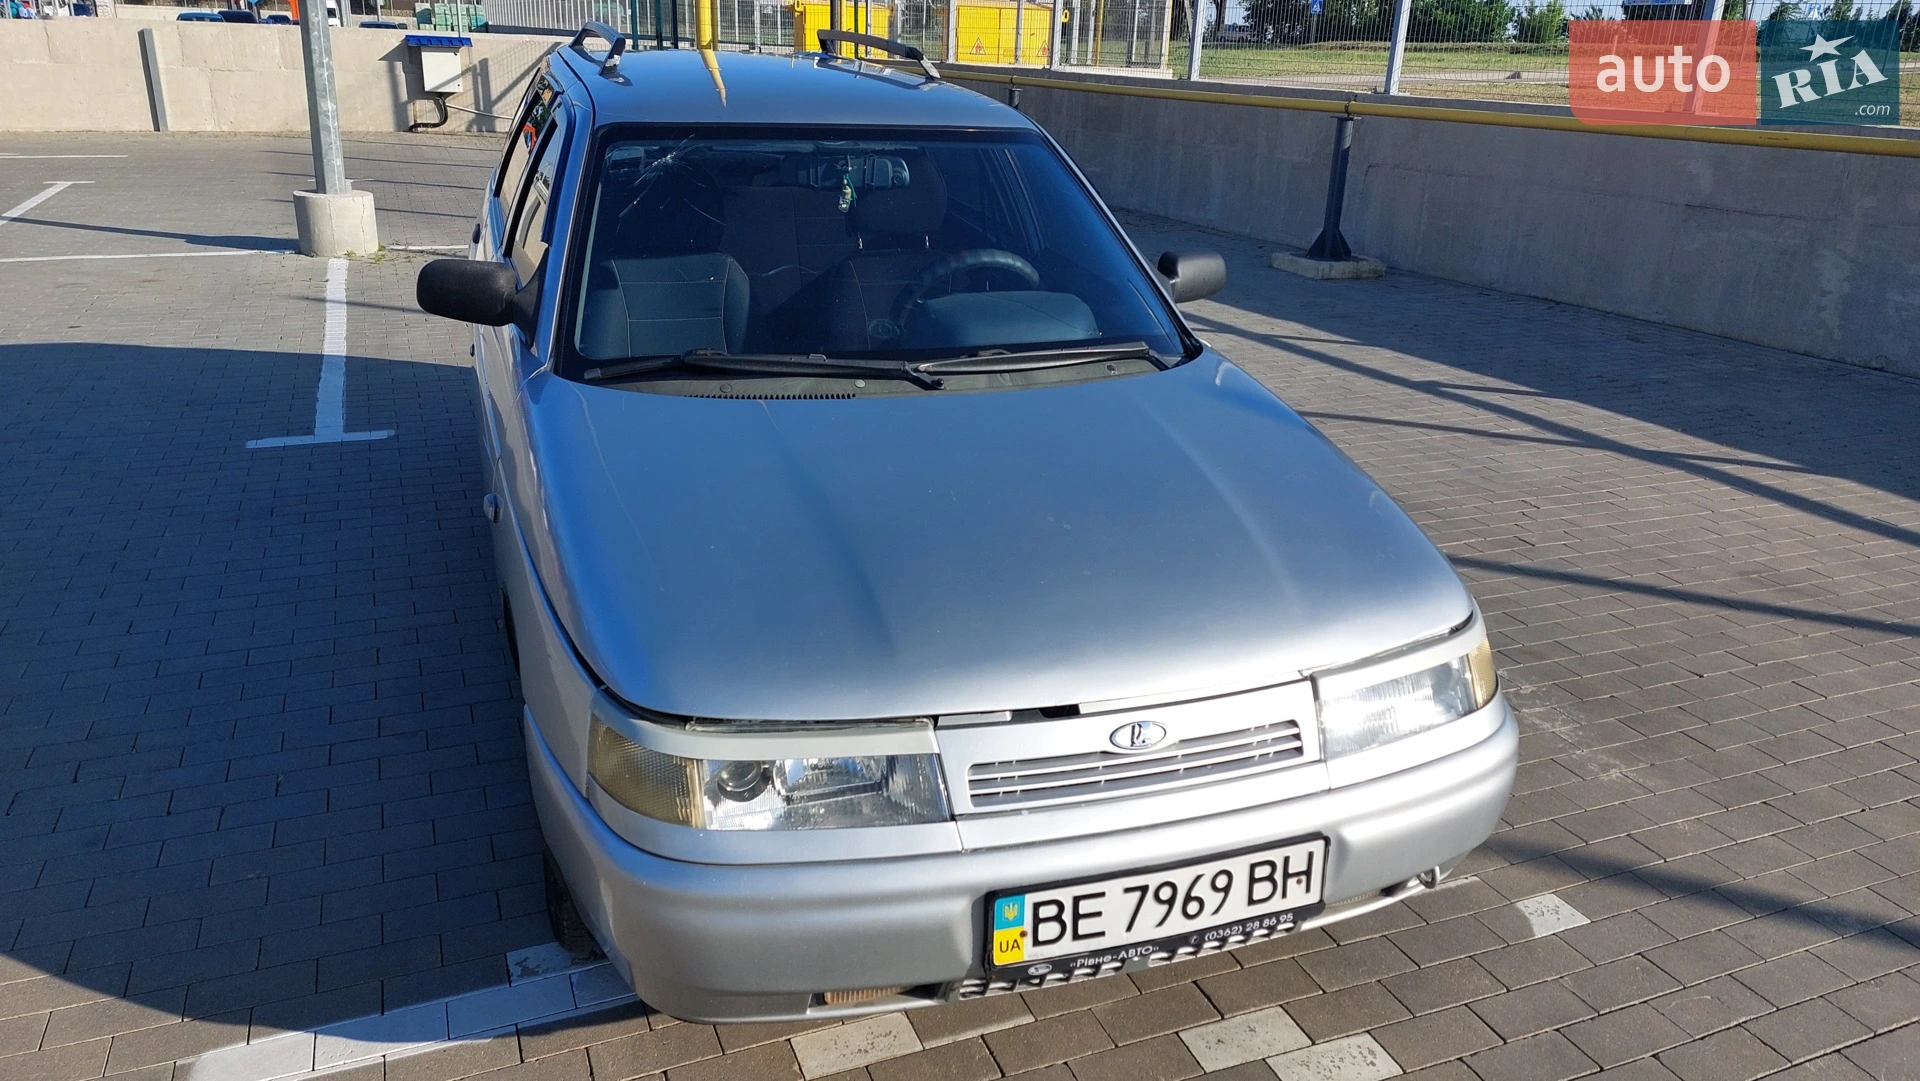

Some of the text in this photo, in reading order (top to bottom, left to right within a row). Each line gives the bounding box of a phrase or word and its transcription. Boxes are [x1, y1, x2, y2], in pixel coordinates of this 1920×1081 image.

[1123, 868, 1234, 933] 7969
[1204, 913, 1294, 942] (0362) 28 86 95
[999, 939, 1021, 954] UA
